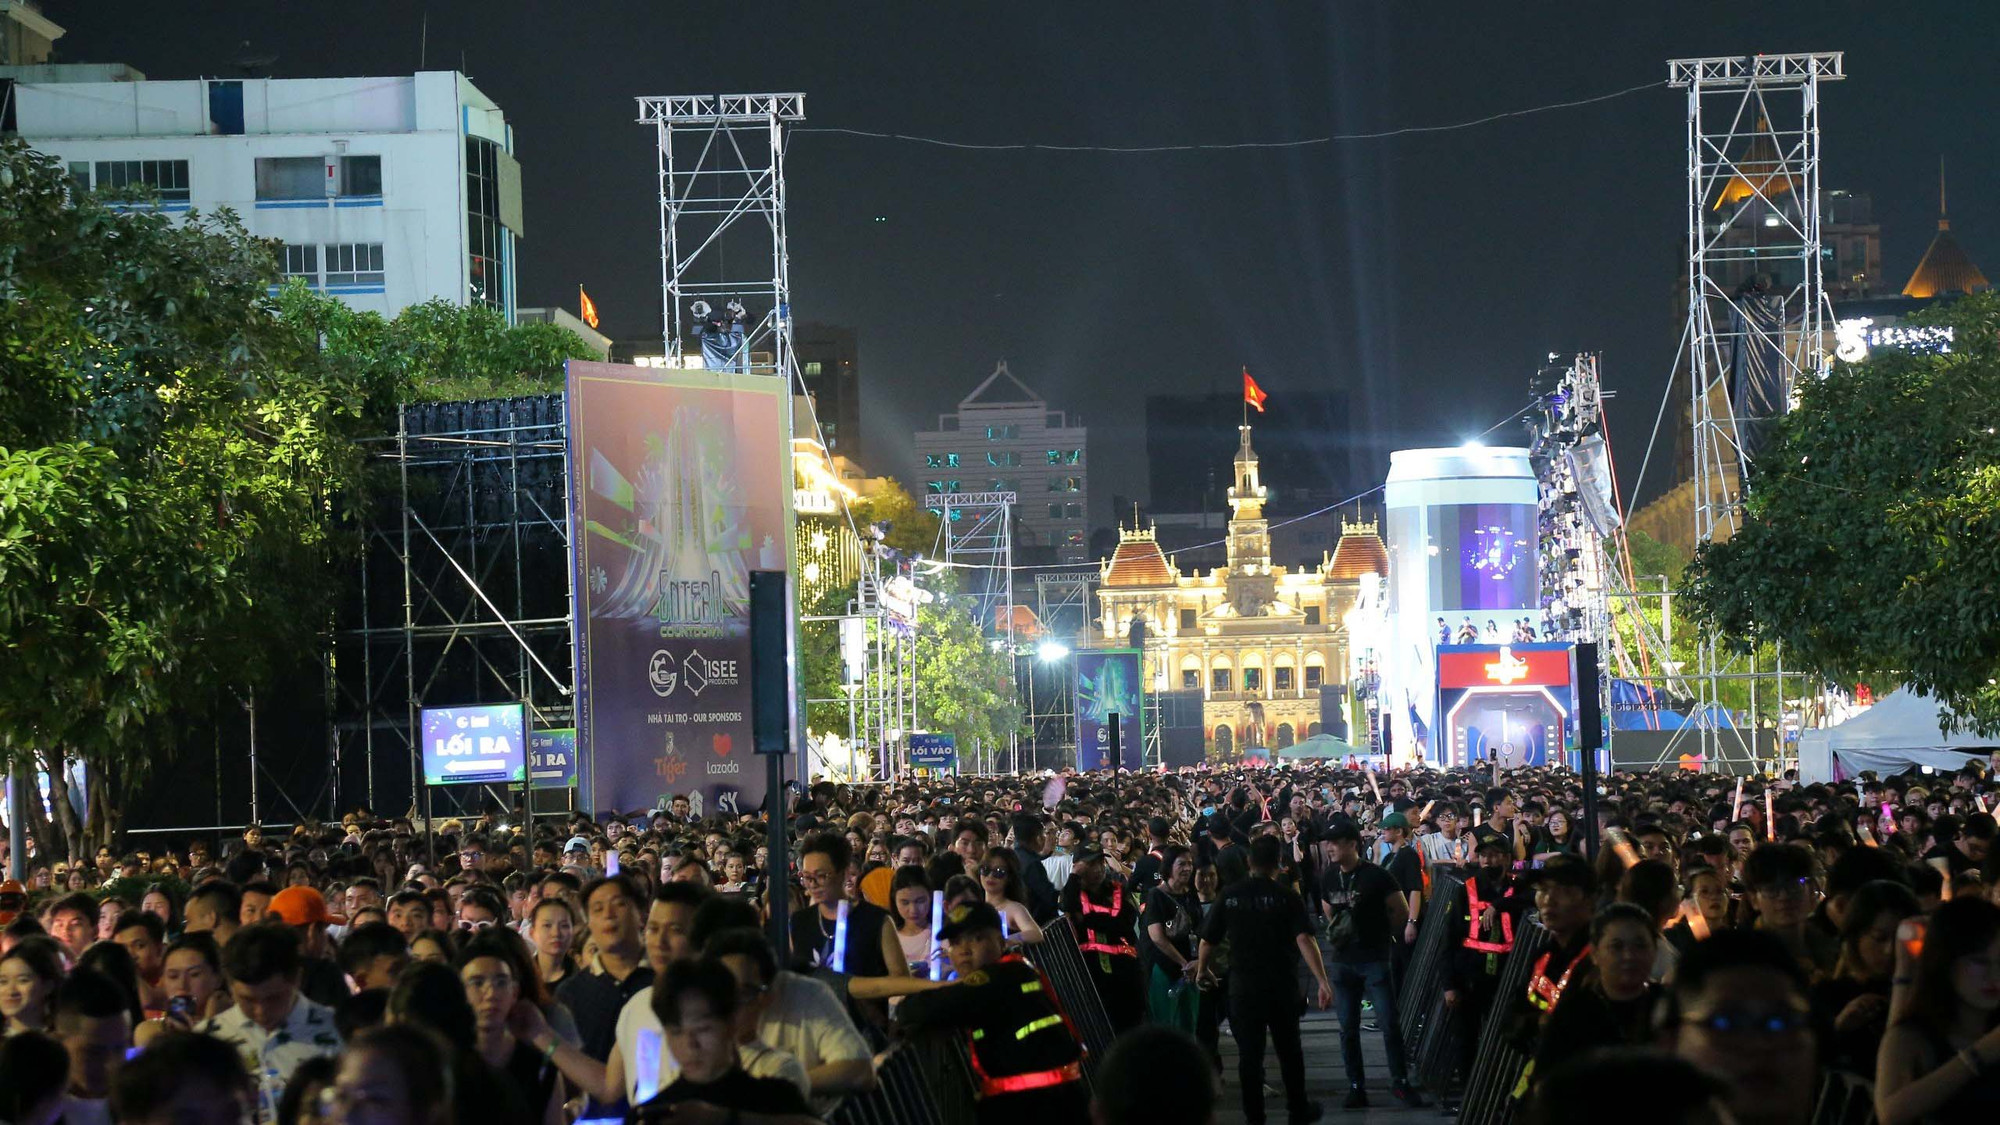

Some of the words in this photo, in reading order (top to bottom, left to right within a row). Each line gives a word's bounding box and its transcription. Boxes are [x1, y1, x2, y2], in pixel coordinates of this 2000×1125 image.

[659, 569, 723, 623] ENTERA
[661, 626, 724, 638] COUNTDOWN
[708, 678, 738, 686] PRODUCTION
[647, 711, 662, 724] NHÀ
[664, 711, 674, 723] TÀI
[693, 713, 707, 722] OUR
[708, 712, 742, 722] SPONSORS
[436, 732, 473, 756] LỐI
[480, 735, 512, 754] RA
[912, 745, 927, 755] LỐI
[931, 745, 952, 755] VÀO
[547, 753, 566, 767] RA
[706, 759, 740, 774] Lazada
[654, 757, 688, 784] Tiger
